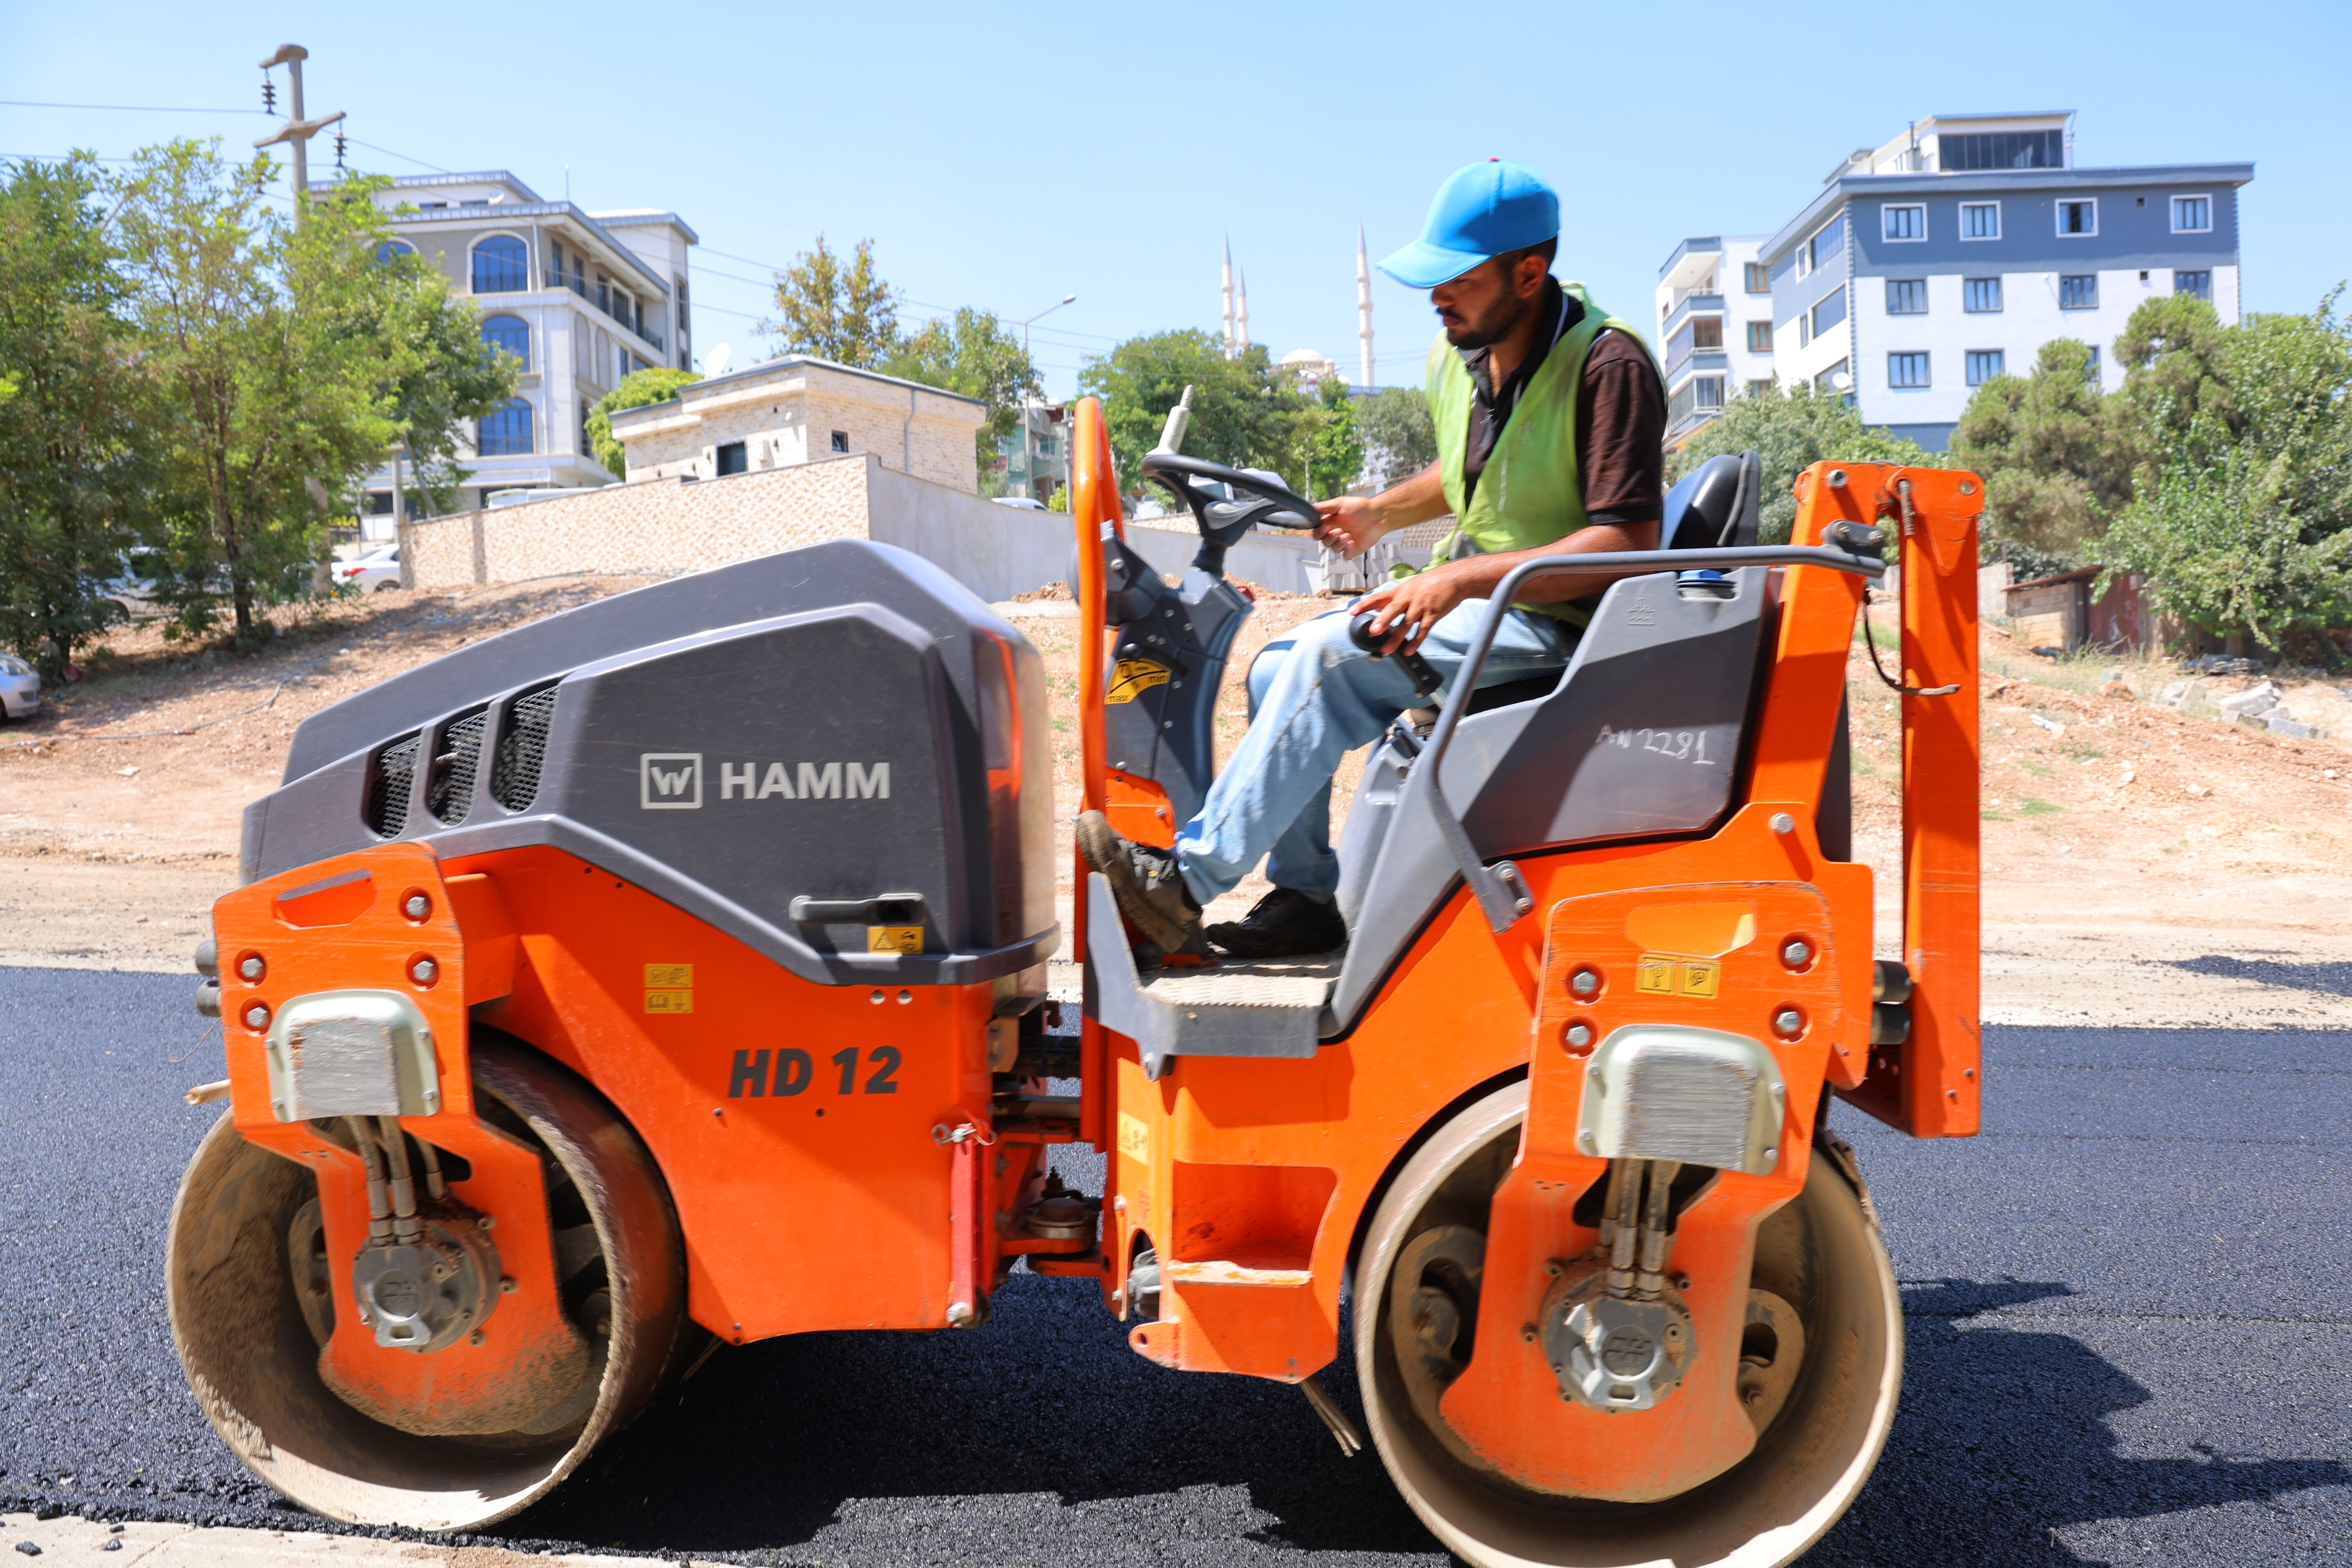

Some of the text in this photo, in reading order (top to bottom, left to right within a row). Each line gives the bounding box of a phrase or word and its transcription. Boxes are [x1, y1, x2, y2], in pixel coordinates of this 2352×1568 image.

[1636, 728, 1716, 765] 2281
[720, 762, 891, 799] HAMM
[728, 1045, 902, 1098] HD 12
